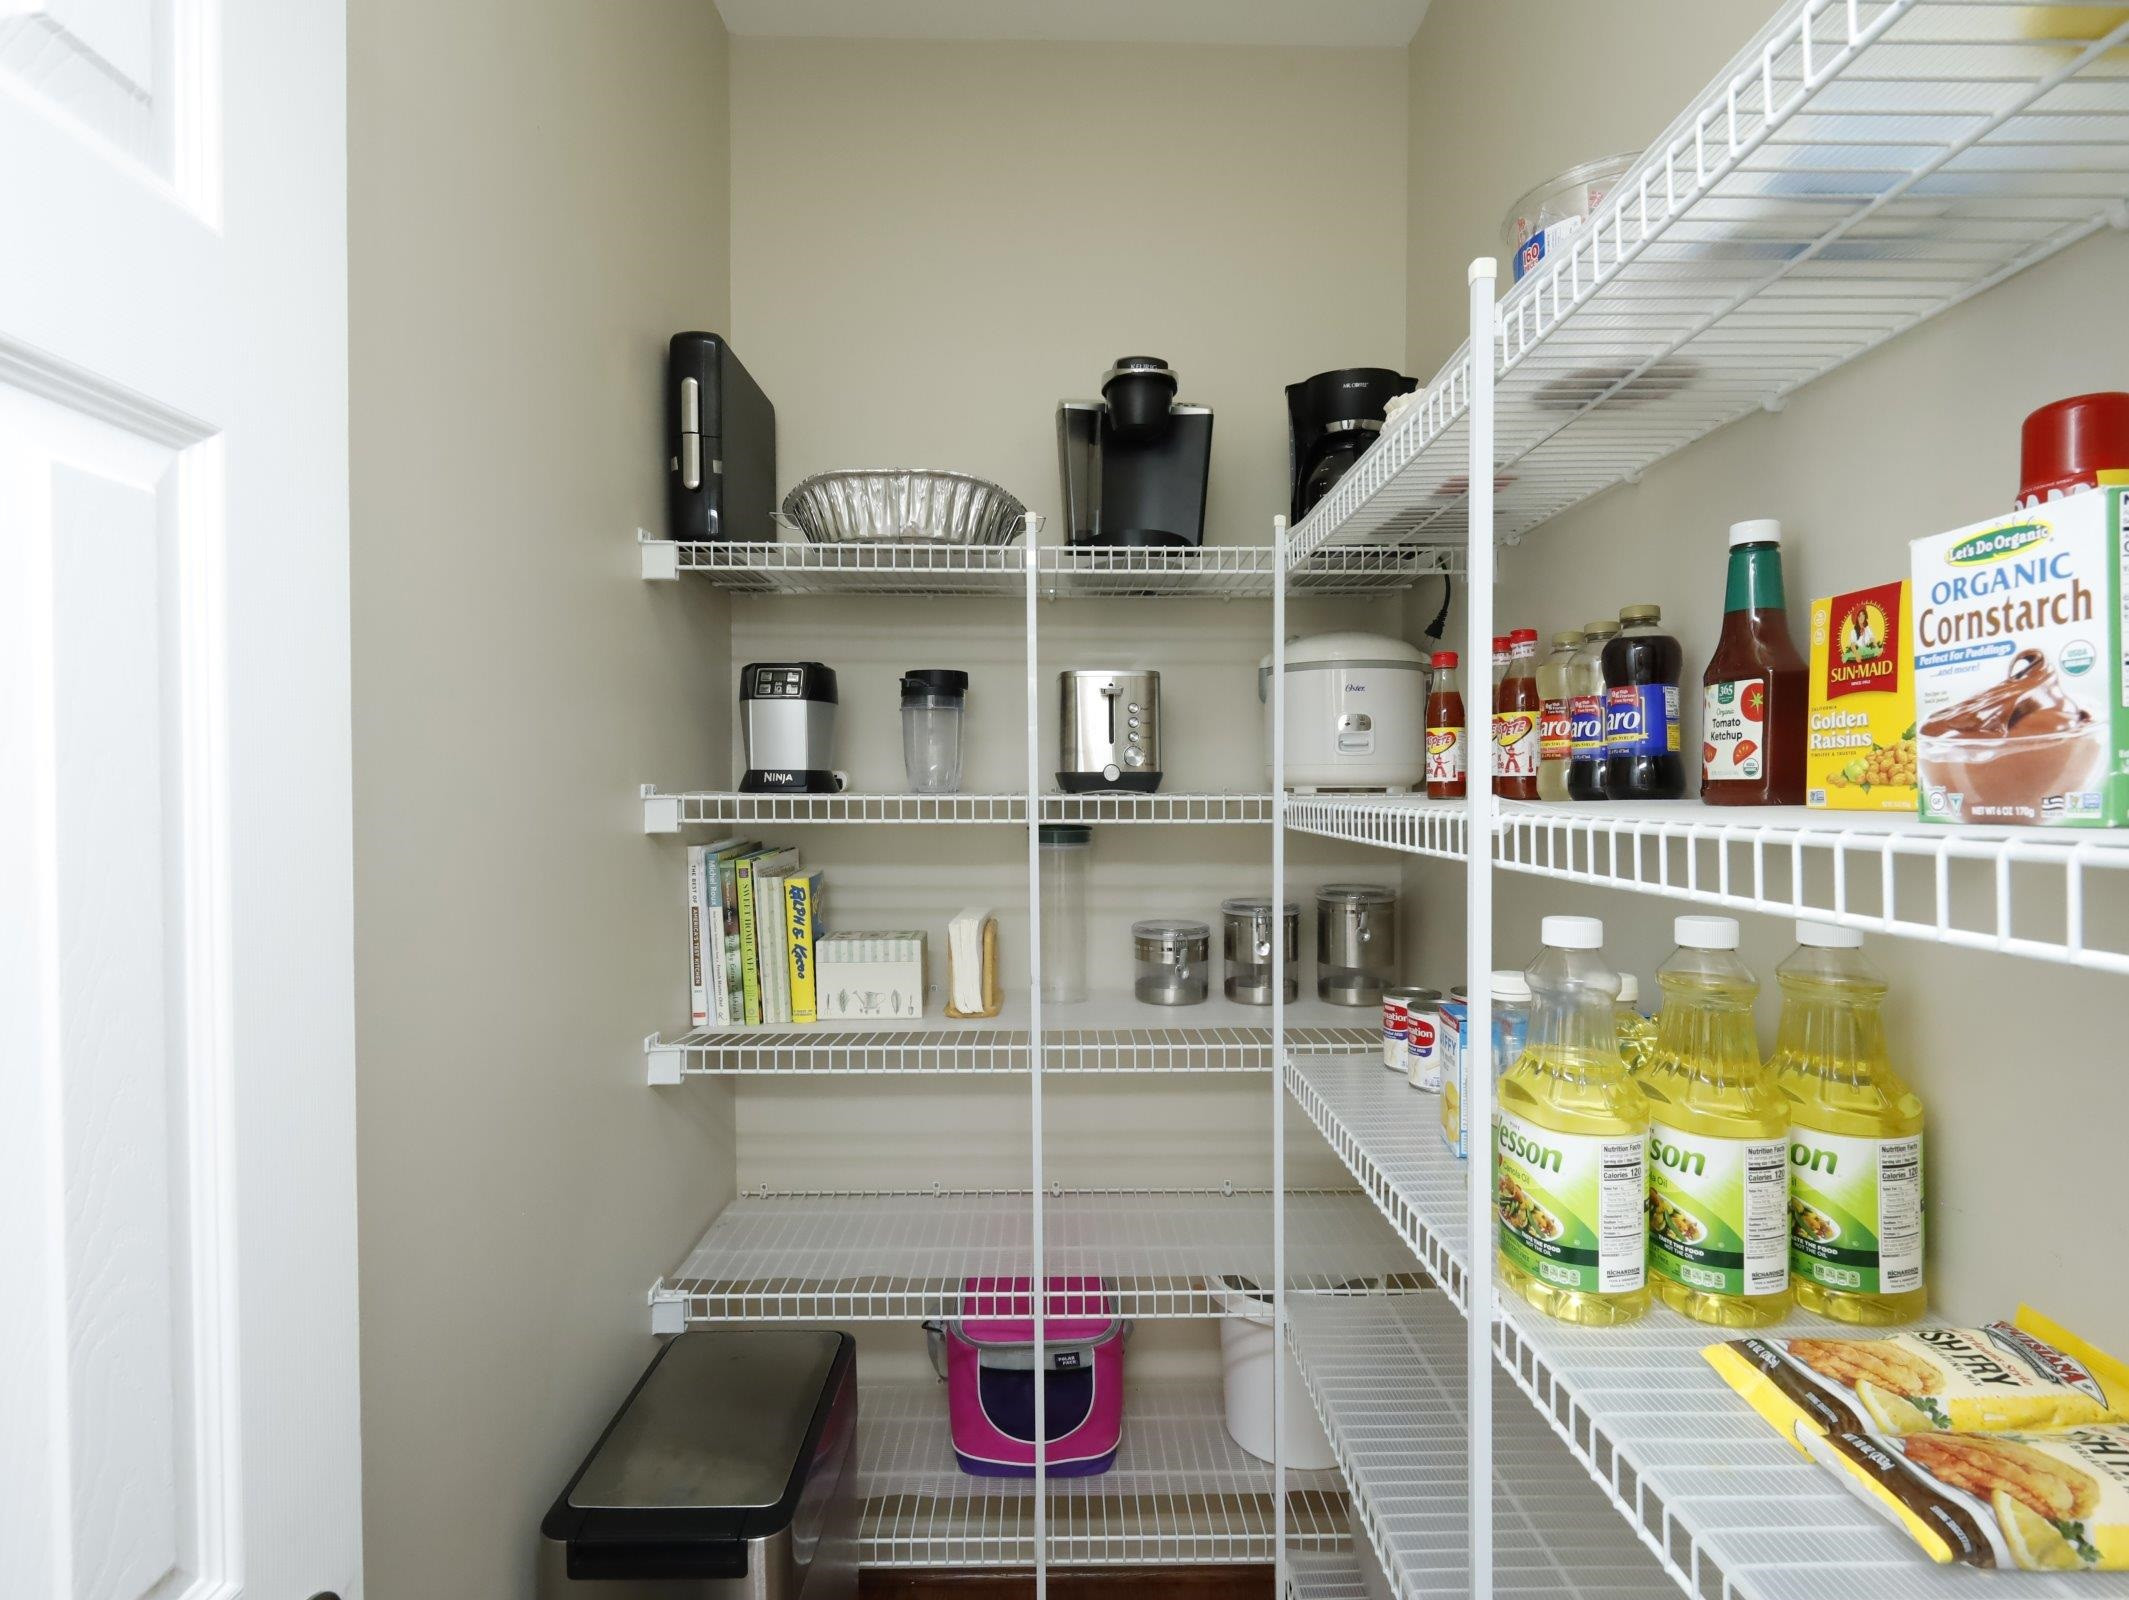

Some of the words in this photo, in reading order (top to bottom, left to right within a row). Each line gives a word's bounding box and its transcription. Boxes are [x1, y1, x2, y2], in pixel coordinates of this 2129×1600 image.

[1948, 545, 1974, 562] Let's
[1976, 540, 1993, 554] Do
[1994, 524, 2049, 551] Organic
[1931, 552, 2073, 605] ORGANIC
[1919, 578, 2093, 648] Cornstarch
[1919, 651, 1949, 666] Perfect
[1949, 648, 1964, 661] For
[1965, 642, 2011, 659] Puddings
[1345, 684, 1365, 692] Oster
[1720, 684, 1733, 696] 365
[1716, 708, 1734, 717] Organic
[1607, 711, 1640, 731] aro
[1712, 718, 1740, 728] Tomato
[1811, 710, 1868, 731] Golden
[1501, 720, 1527, 736] PETE
[1541, 720, 1570, 737] aro
[1571, 720, 1600, 738] aro
[1432, 734, 1452, 748] PETE
[1710, 730, 1742, 741] Ketchup
[1810, 730, 1872, 750] Raisins
[763, 772, 794, 784] NINJA
[1971, 806, 1984, 816] NET
[2016, 806, 2035, 818] 170g
[708, 860, 717, 885] Michel
[692, 895, 698, 904] OF
[788, 885, 806, 926] RALPH
[792, 928, 804, 940] &
[1603, 1144, 1629, 1153] Nutrition
[1748, 1147, 1774, 1156] Nutrition
[1882, 1146, 1906, 1154] Nutrition
[1650, 1138, 1706, 1177] son
[1791, 1142, 1838, 1175] on
[1521, 1172, 1530, 1184] Oil
[1604, 1172, 1628, 1180] Calories
[1630, 1168, 1642, 1177] 120
[1748, 1174, 1772, 1182] Calories
[1774, 1170, 1785, 1180] 120
[1882, 1172, 1906, 1180] Calories
[1908, 1168, 1918, 1177] 120
[1657, 1177, 1668, 1188] Oil
[1544, 1242, 1562, 1254] FOOD
[1673, 1240, 1684, 1250] THE
[1684, 1246, 1704, 1257] FOOD
[1805, 1241, 1816, 1251] THE
[1817, 1244, 1838, 1256] FOOD
[1806, 1247, 1816, 1256] THE
[1817, 1250, 1828, 1259] OIL
[1684, 1252, 1694, 1260] OIL
[1919, 1331, 1971, 1352] SH
[1953, 1353, 2021, 1387] FRY
[1962, 1371, 1984, 1387] MIX
